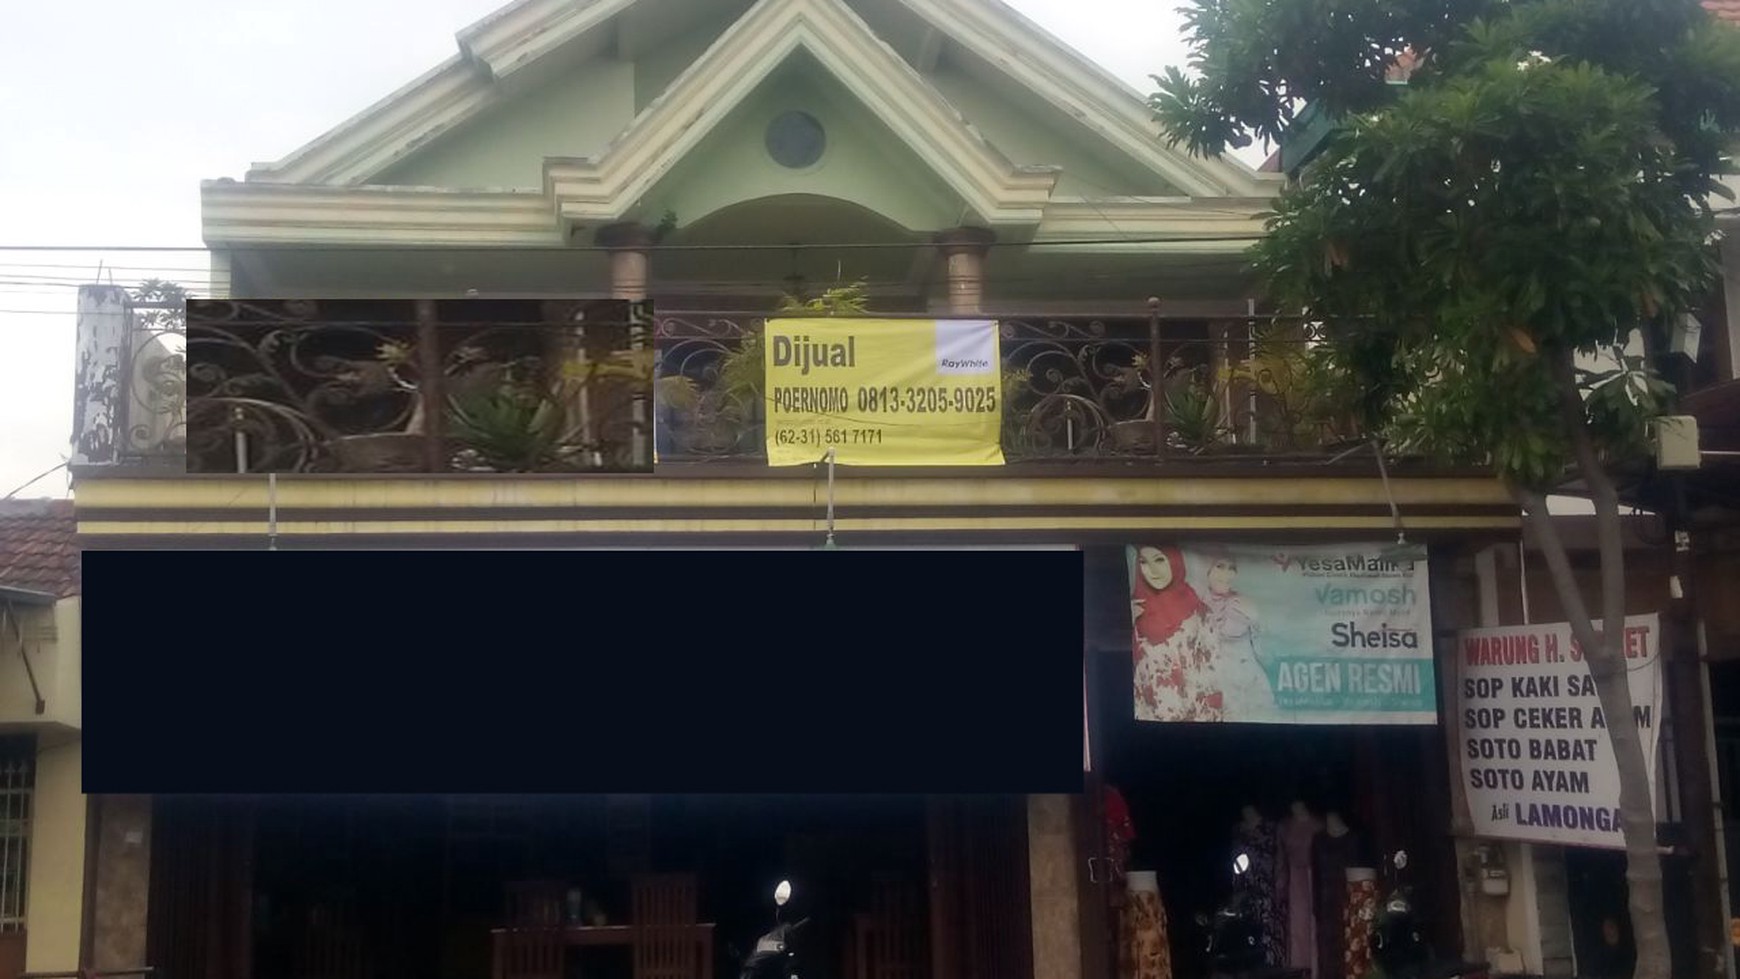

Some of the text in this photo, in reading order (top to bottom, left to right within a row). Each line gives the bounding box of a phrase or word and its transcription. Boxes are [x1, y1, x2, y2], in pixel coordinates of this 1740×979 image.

[773, 336, 855, 375] Dijual
[774, 386, 996, 413] POERNOMO 0813-3205-9025
[775, 429, 882, 447] (62-31) 561 7171
[1331, 621, 1418, 648] Sheisa
[1465, 634, 1540, 666] WARUNG
[1545, 633, 1565, 663] H.
[1278, 661, 1421, 694] AGEN RESMI
[1465, 677, 1503, 699] SOP
[1511, 675, 1560, 698] KAKI
[1465, 705, 1651, 729] SOP CEKER AM
[1467, 738, 1597, 761] SOTO BABAT
[1470, 768, 1590, 793] SOTO AYAM
[1491, 802, 1625, 832] Asli LAMONGA
